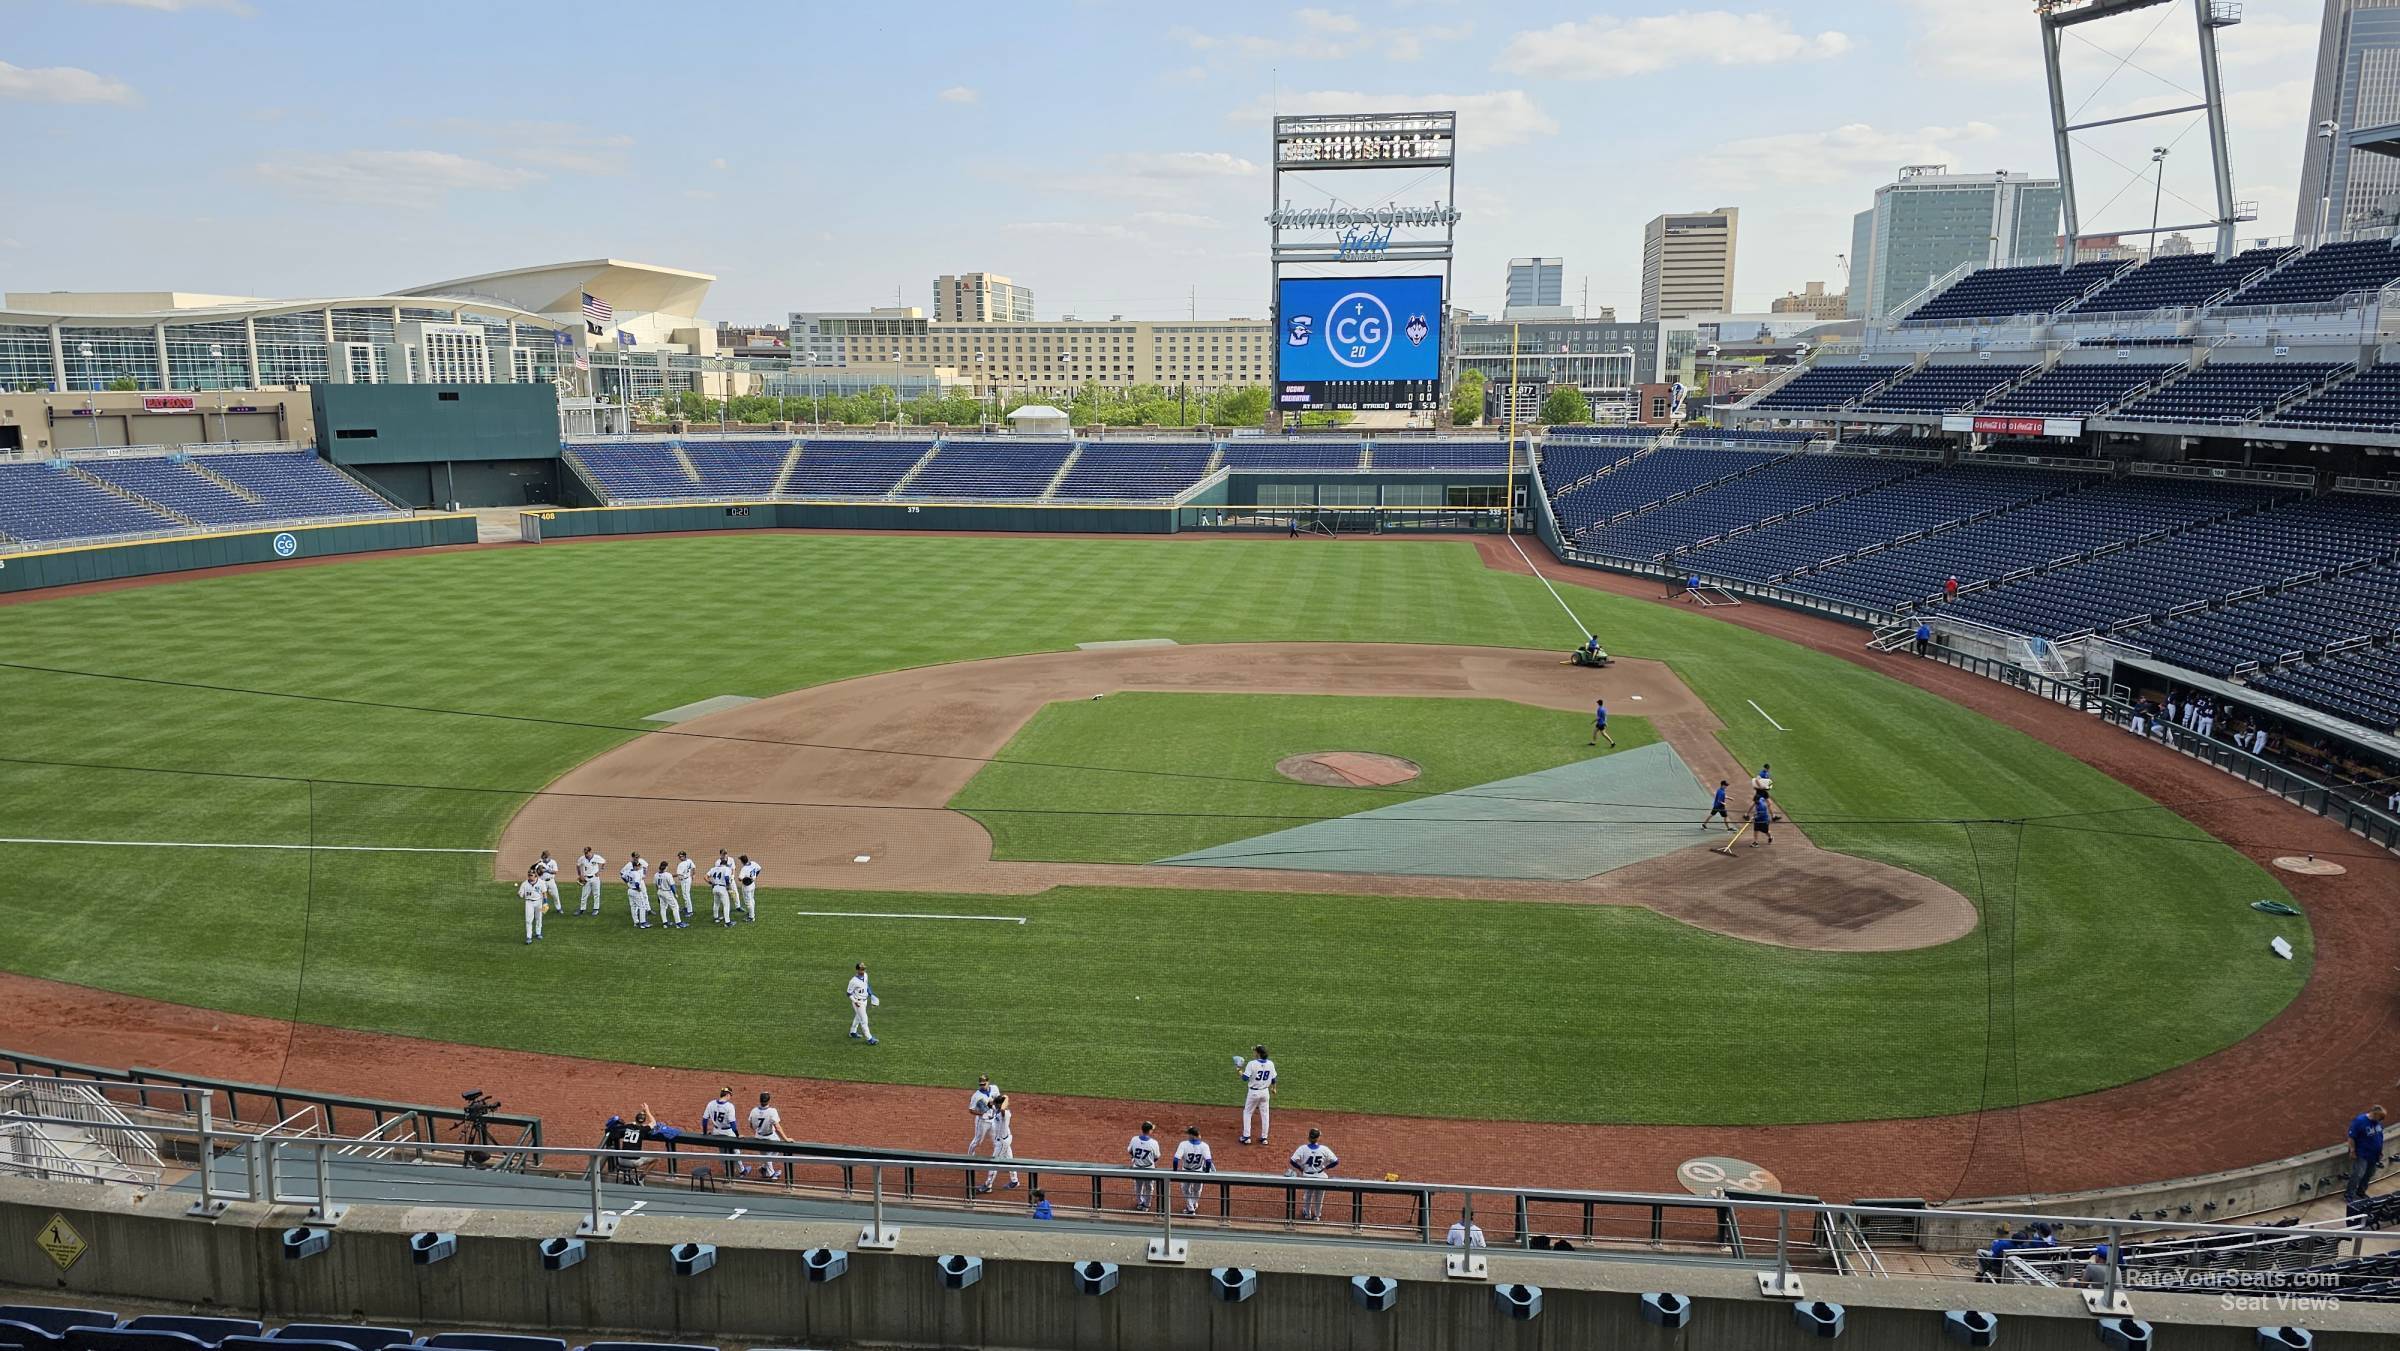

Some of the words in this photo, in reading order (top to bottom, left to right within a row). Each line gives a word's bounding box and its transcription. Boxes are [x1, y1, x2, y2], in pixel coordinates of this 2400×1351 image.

[1268, 199, 1359, 227] charles
[1333, 226, 1392, 259] field
[1336, 317, 1381, 344] CG
[1350, 346, 1366, 358] 20
[278, 540, 293, 549] CG
[1255, 1071, 1270, 1081] 38
[713, 1111, 725, 1123] 15
[757, 1118, 765, 1127] 7
[624, 1129, 639, 1143] 20
[1135, 1148, 1151, 1159] 27
[1186, 1153, 1203, 1164] 33
[1305, 1156, 1322, 1167] 45
